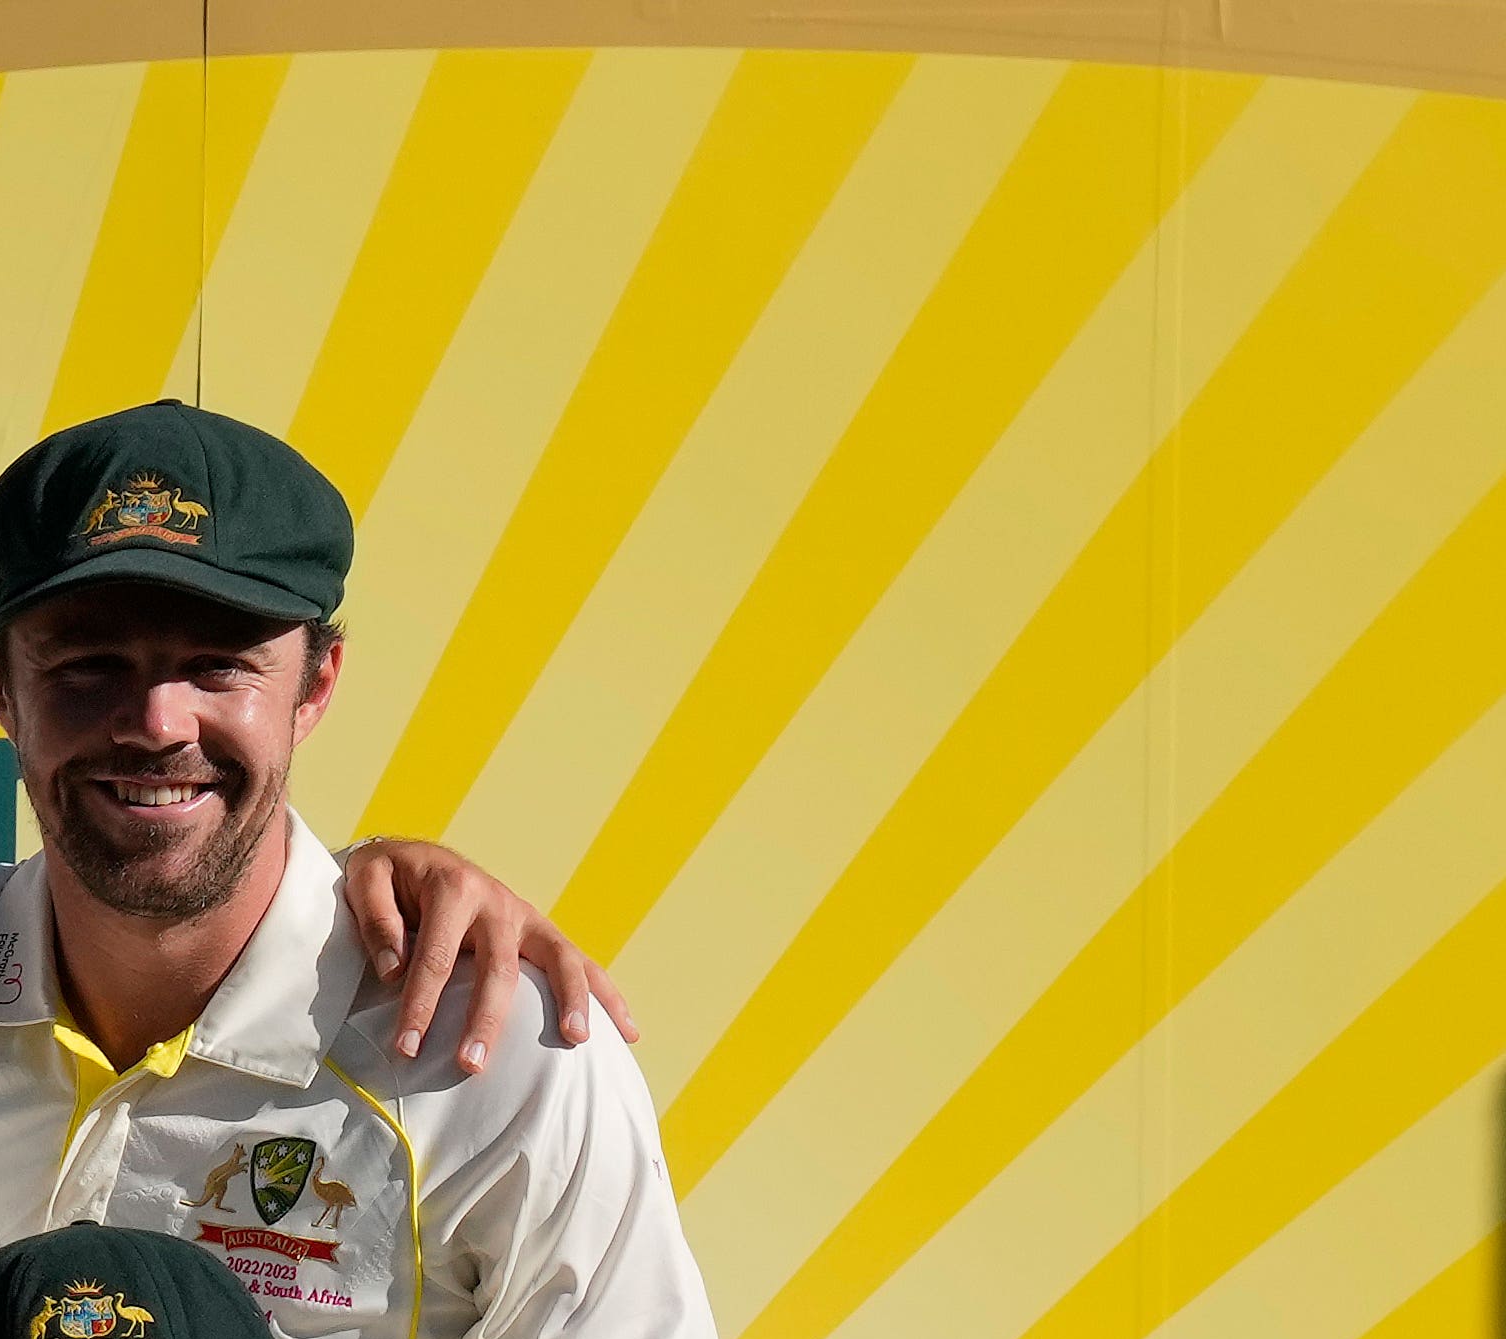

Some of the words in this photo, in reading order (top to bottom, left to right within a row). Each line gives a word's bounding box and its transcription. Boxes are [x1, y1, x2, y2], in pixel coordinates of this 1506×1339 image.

[226, 1229, 309, 1258] AUSTRALIA
[226, 1256, 299, 1281] 2022/2023
[262, 1282, 304, 1300] South
[307, 1288, 355, 1308] Africa
